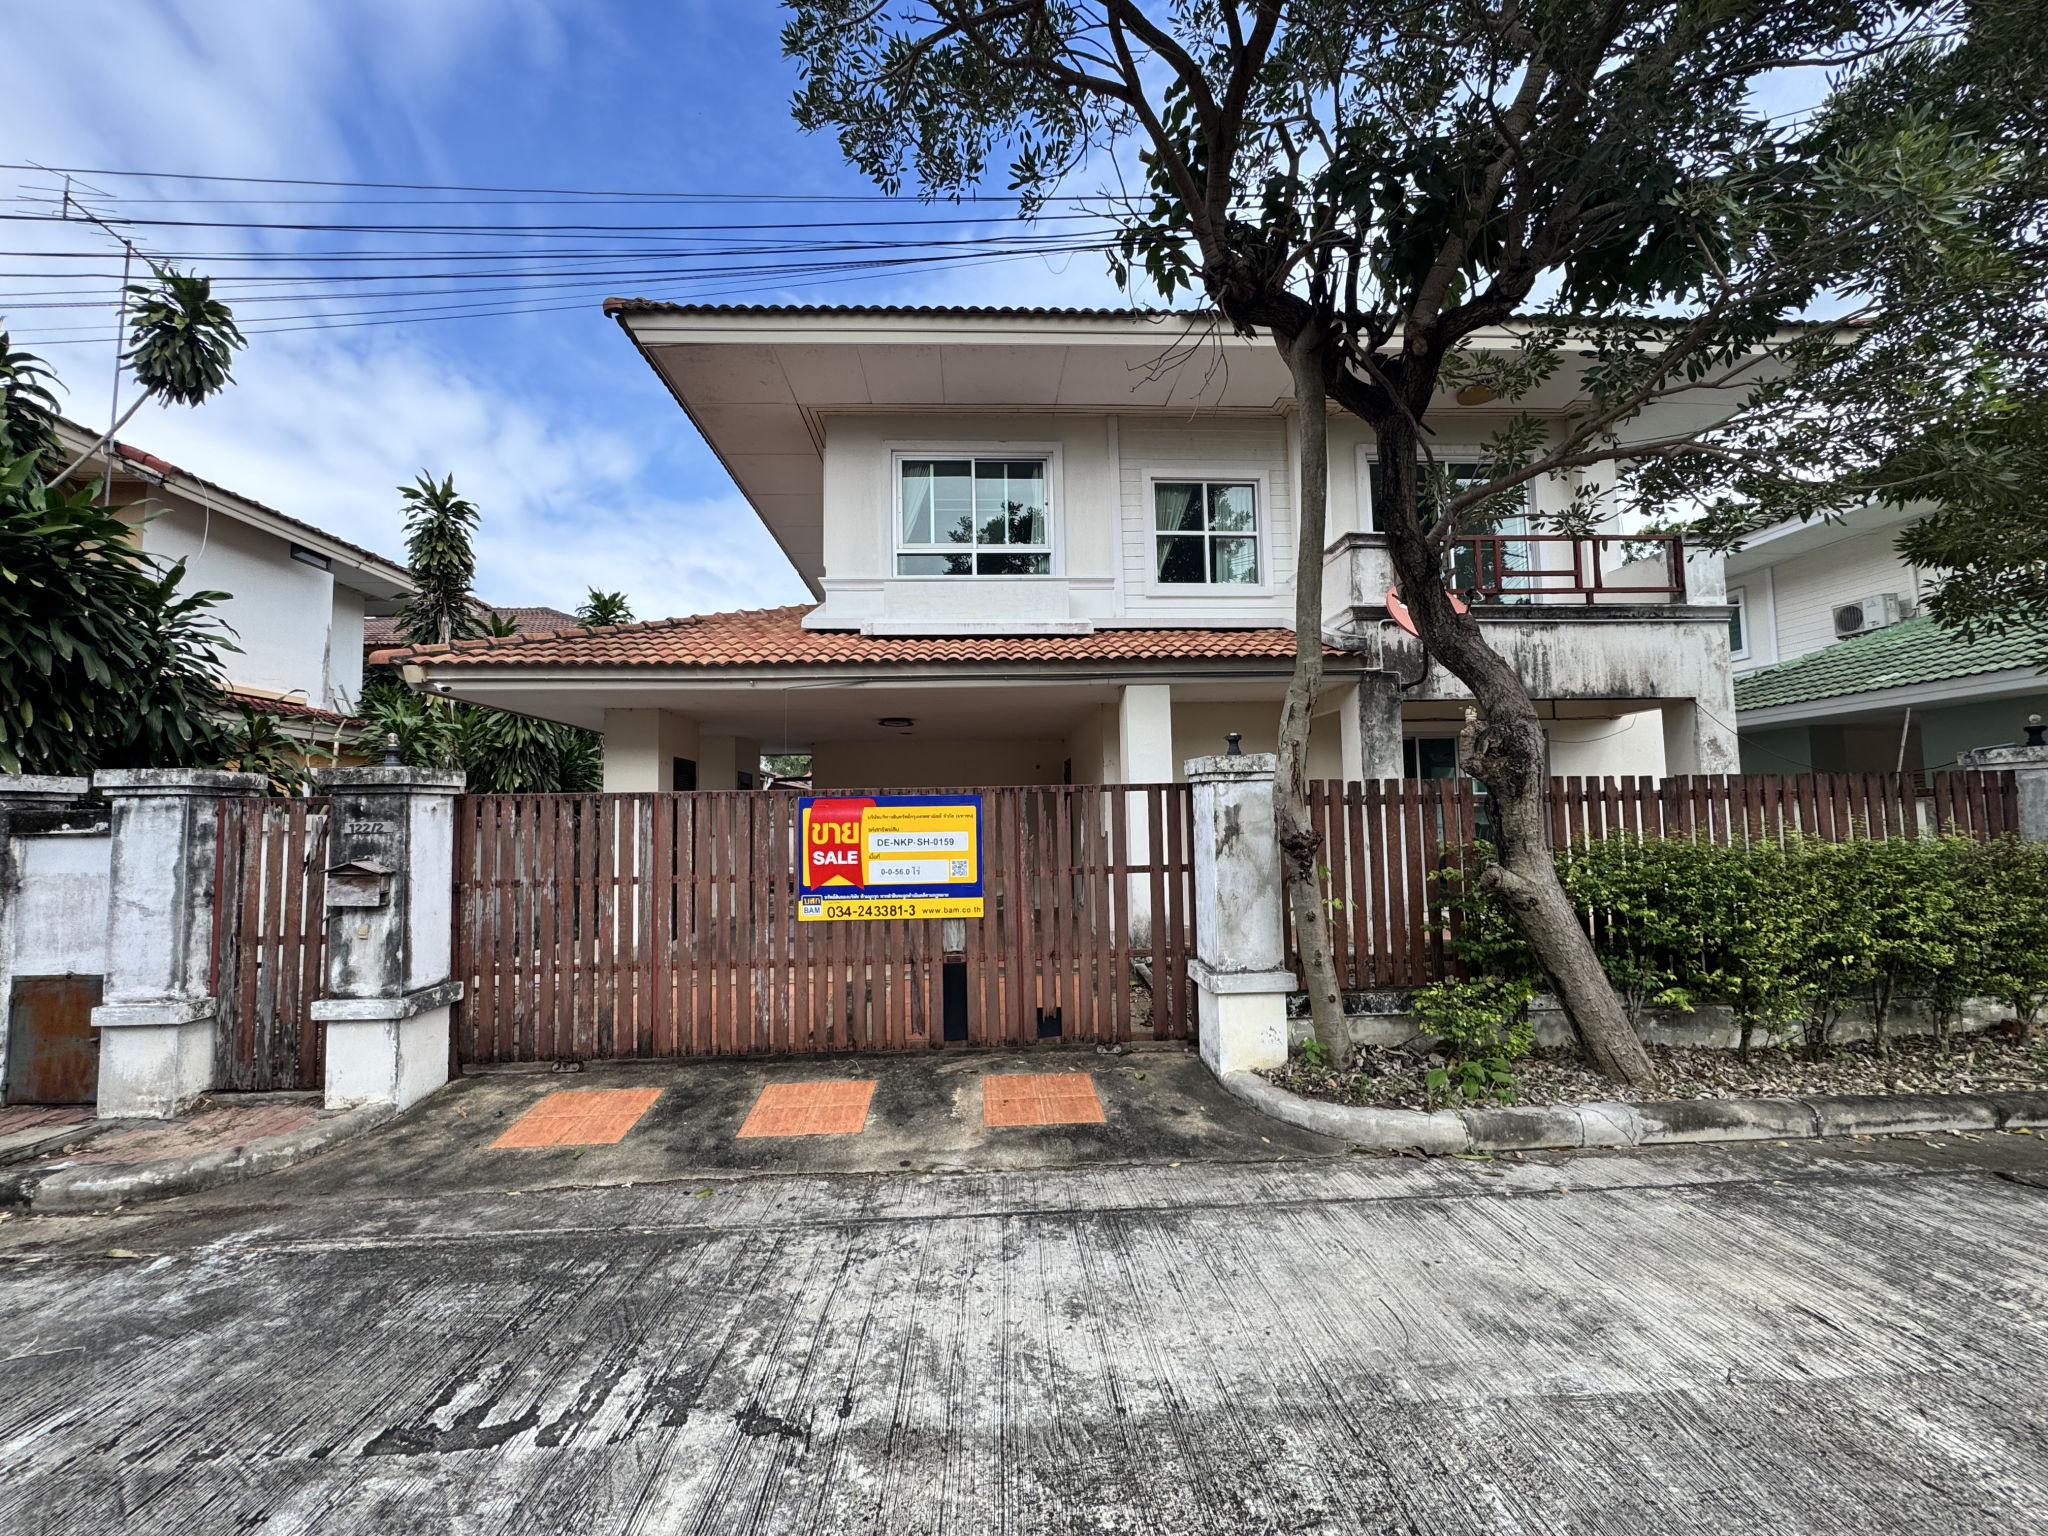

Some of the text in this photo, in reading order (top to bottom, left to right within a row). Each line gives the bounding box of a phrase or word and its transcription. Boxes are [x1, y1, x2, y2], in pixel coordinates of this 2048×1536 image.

[349, 822, 384, 833] 122/2
[812, 822, 859, 845] ขาย
[877, 838, 954, 846] DE-NKP-SH-0159
[812, 850, 858, 865] SALE
[827, 904, 981, 918] 034-243381-3 www.bam.co.th
